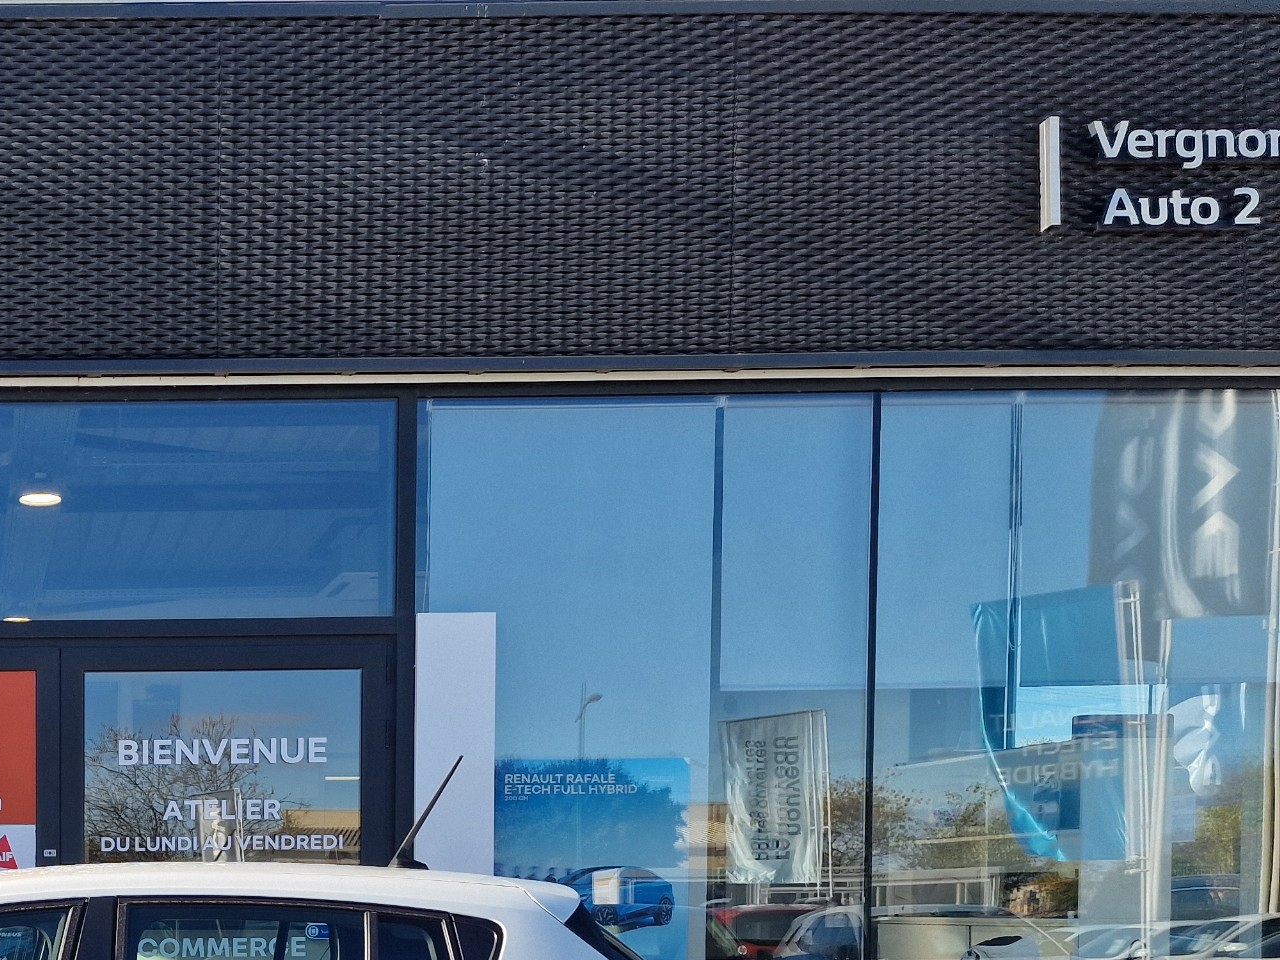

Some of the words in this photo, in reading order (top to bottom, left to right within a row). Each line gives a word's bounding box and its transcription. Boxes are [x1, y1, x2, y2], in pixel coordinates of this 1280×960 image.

[1103, 188, 1220, 225] Auto
[1233, 187, 1261, 225] 2
[118, 737, 328, 766] BIENVENUE
[504, 774, 564, 784] RENAULT
[567, 773, 616, 784] RAFALE
[504, 784, 551, 795] E-TECH
[553, 784, 586, 795] FULL
[588, 784, 638, 795] HYBRID
[163, 799, 281, 821] ATELIER
[100, 836, 131, 852] DU
[134, 836, 199, 851] LUNDI
[203, 836, 232, 851] AU
[236, 834, 344, 850] VENDREDI
